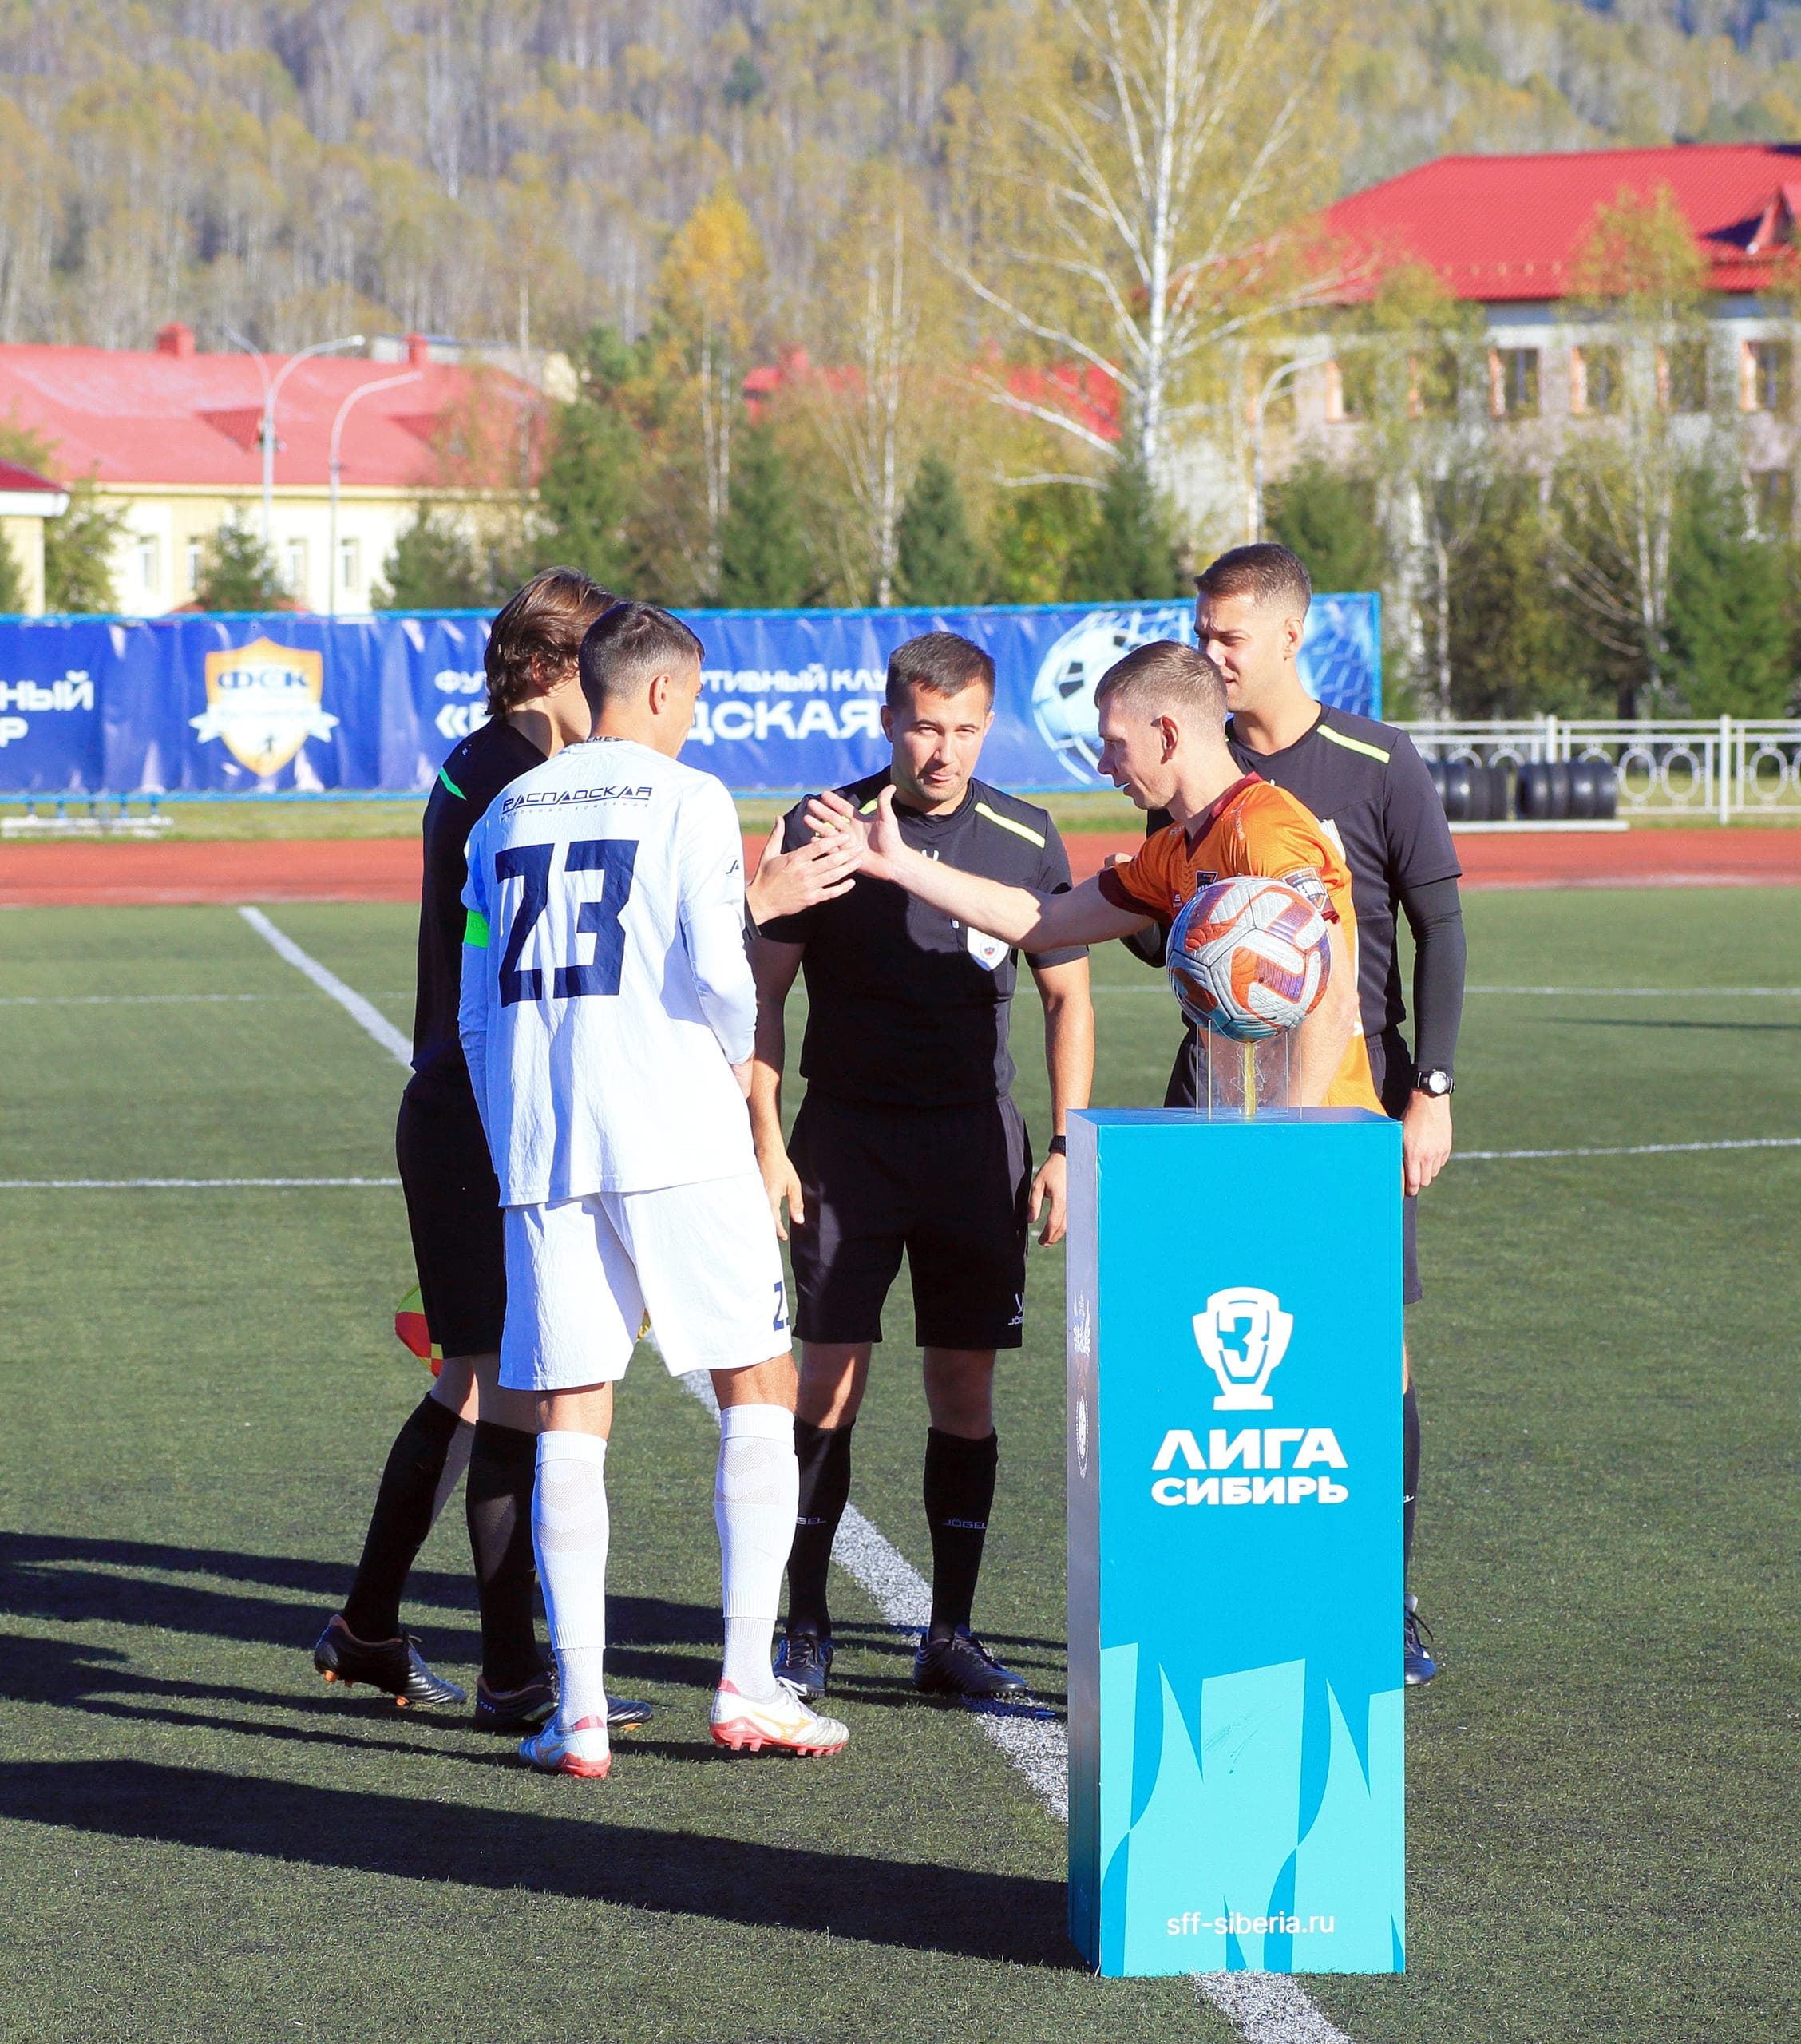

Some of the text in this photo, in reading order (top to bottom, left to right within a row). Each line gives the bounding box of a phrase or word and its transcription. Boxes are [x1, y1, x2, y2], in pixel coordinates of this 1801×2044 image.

[0, 669, 94, 712] НЫЙ
[434, 669, 488, 695] ФУ
[831, 669, 889, 692] КЛУ
[0, 716, 29, 748] Р
[687, 699, 884, 746] ДСКАЯ
[502, 786, 653, 814] РАСПАДСКАЯ
[495, 839, 639, 1008] 23
[773, 1281, 791, 1332] 2
[1152, 1428, 1348, 1471] ЛИГА
[1151, 1476, 1349, 1507] СИБИРЬ
[1166, 1911, 1335, 1935] sff-siberia.ru
